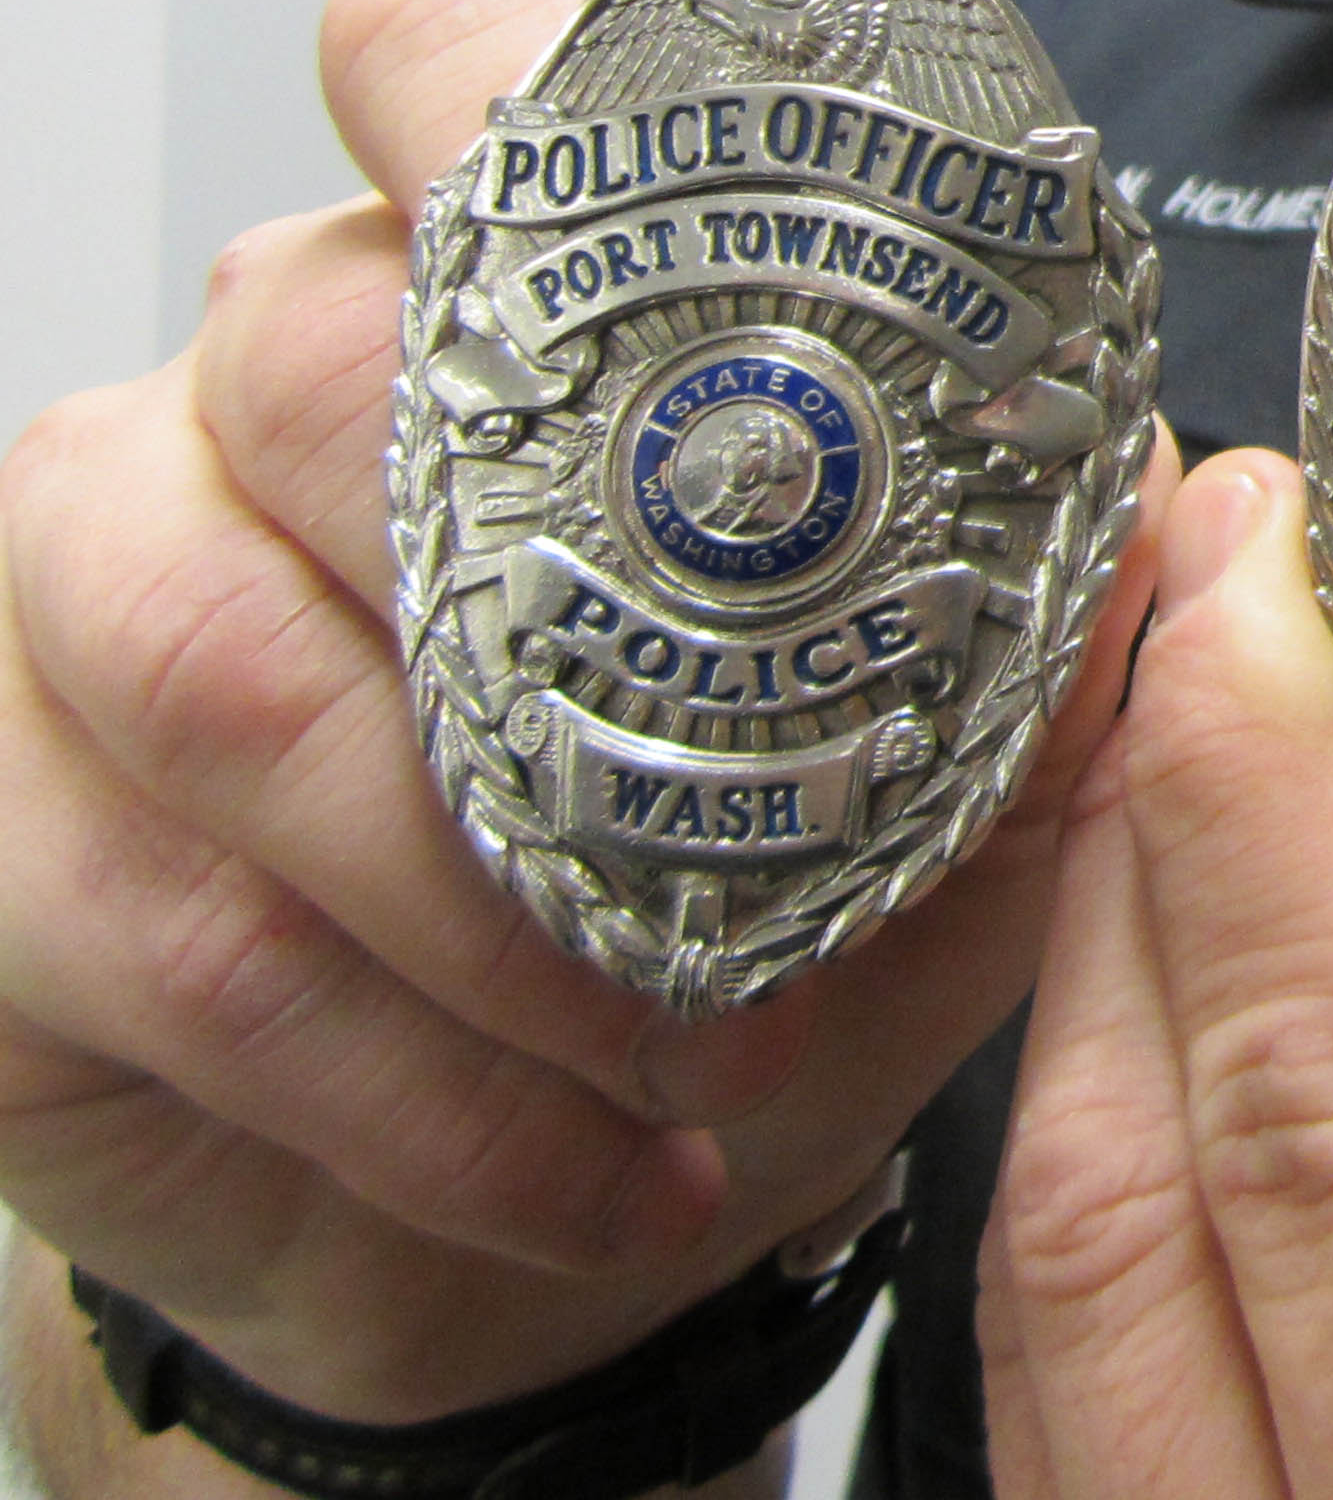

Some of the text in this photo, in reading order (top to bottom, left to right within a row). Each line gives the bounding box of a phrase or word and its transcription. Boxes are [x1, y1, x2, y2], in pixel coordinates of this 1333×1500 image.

[493, 94, 1069, 251] POLICE OFFICER
[528, 210, 1010, 347] PORT TOWNSEND
[666, 366, 843, 428] STATE OF
[641, 474, 846, 573] WASHINGTON
[559, 597, 921, 704] POLICE
[611, 768, 820, 842] WASH.
